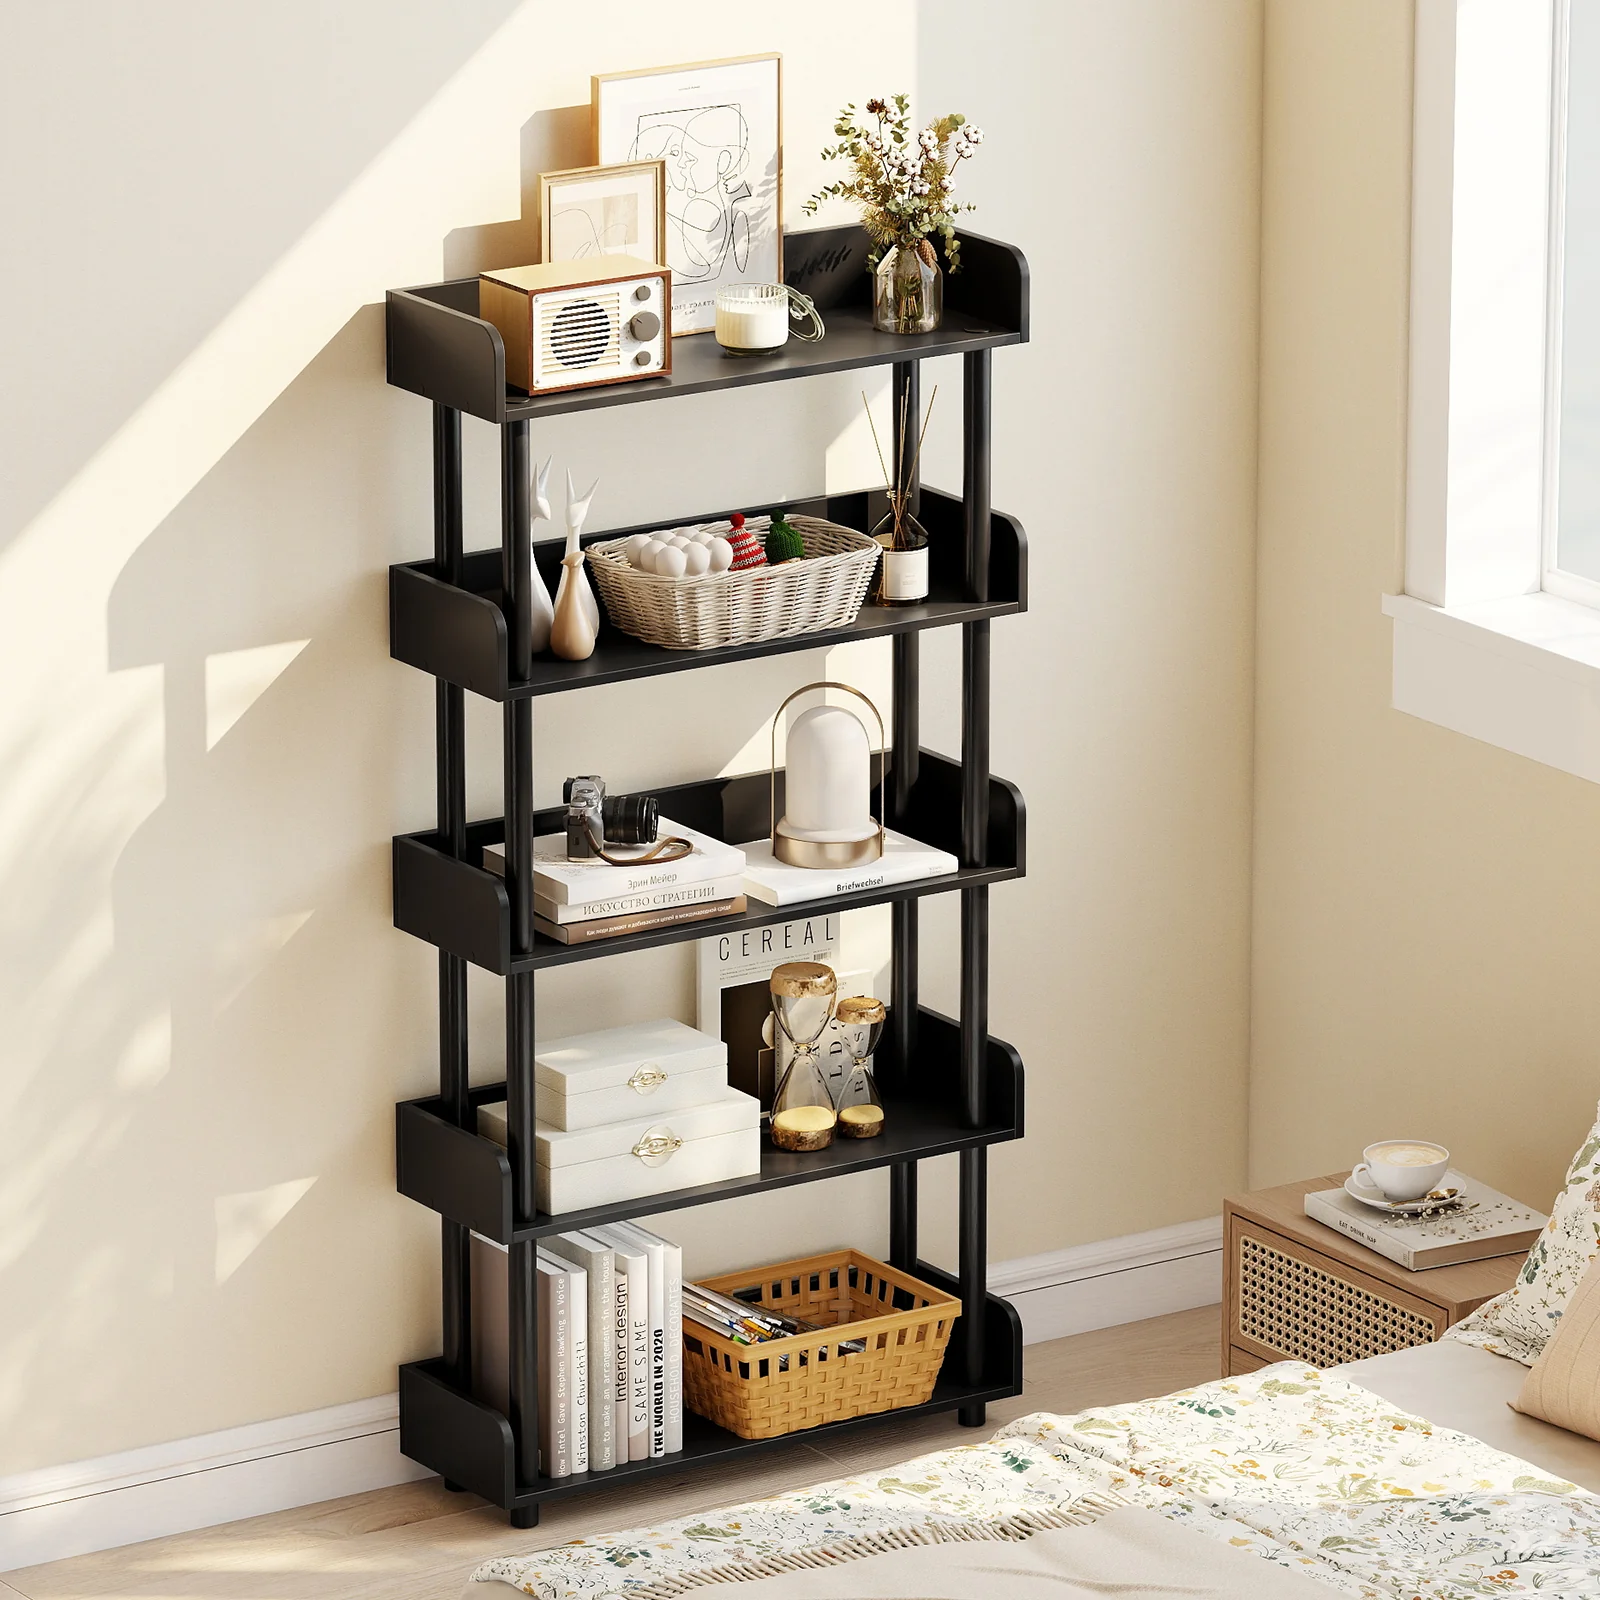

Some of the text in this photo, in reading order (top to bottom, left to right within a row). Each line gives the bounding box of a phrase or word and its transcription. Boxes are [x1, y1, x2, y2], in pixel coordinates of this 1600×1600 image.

[628, 873, 678, 890] Эрин Мейер
[836, 875, 884, 892] Briefwechsel
[583, 886, 716, 915] ИСКУССТВО СТРАТЕГИИ
[719, 917, 834, 961] CEREAL
[1339, 1220, 1377, 1244] EAT DRINK NAP
[556, 1279, 565, 1305] Voice
[557, 1320, 566, 1357] Hawking
[615, 1283, 628, 1402] Interior design
[669, 1278, 680, 1423] HOUSEHOLD DECORATES
[601, 1256, 611, 1464] How to make an arrangement in the house
[634, 1319, 647, 1422] SAME SAME
[557, 1361, 566, 1398] Stephen
[653, 1329, 664, 1454] THE WORLD IN 2020
[557, 1402, 566, 1424] Gave
[576, 1339, 586, 1466] Winston Churchill
[557, 1428, 566, 1454] Intel
[558, 1459, 566, 1475] How
